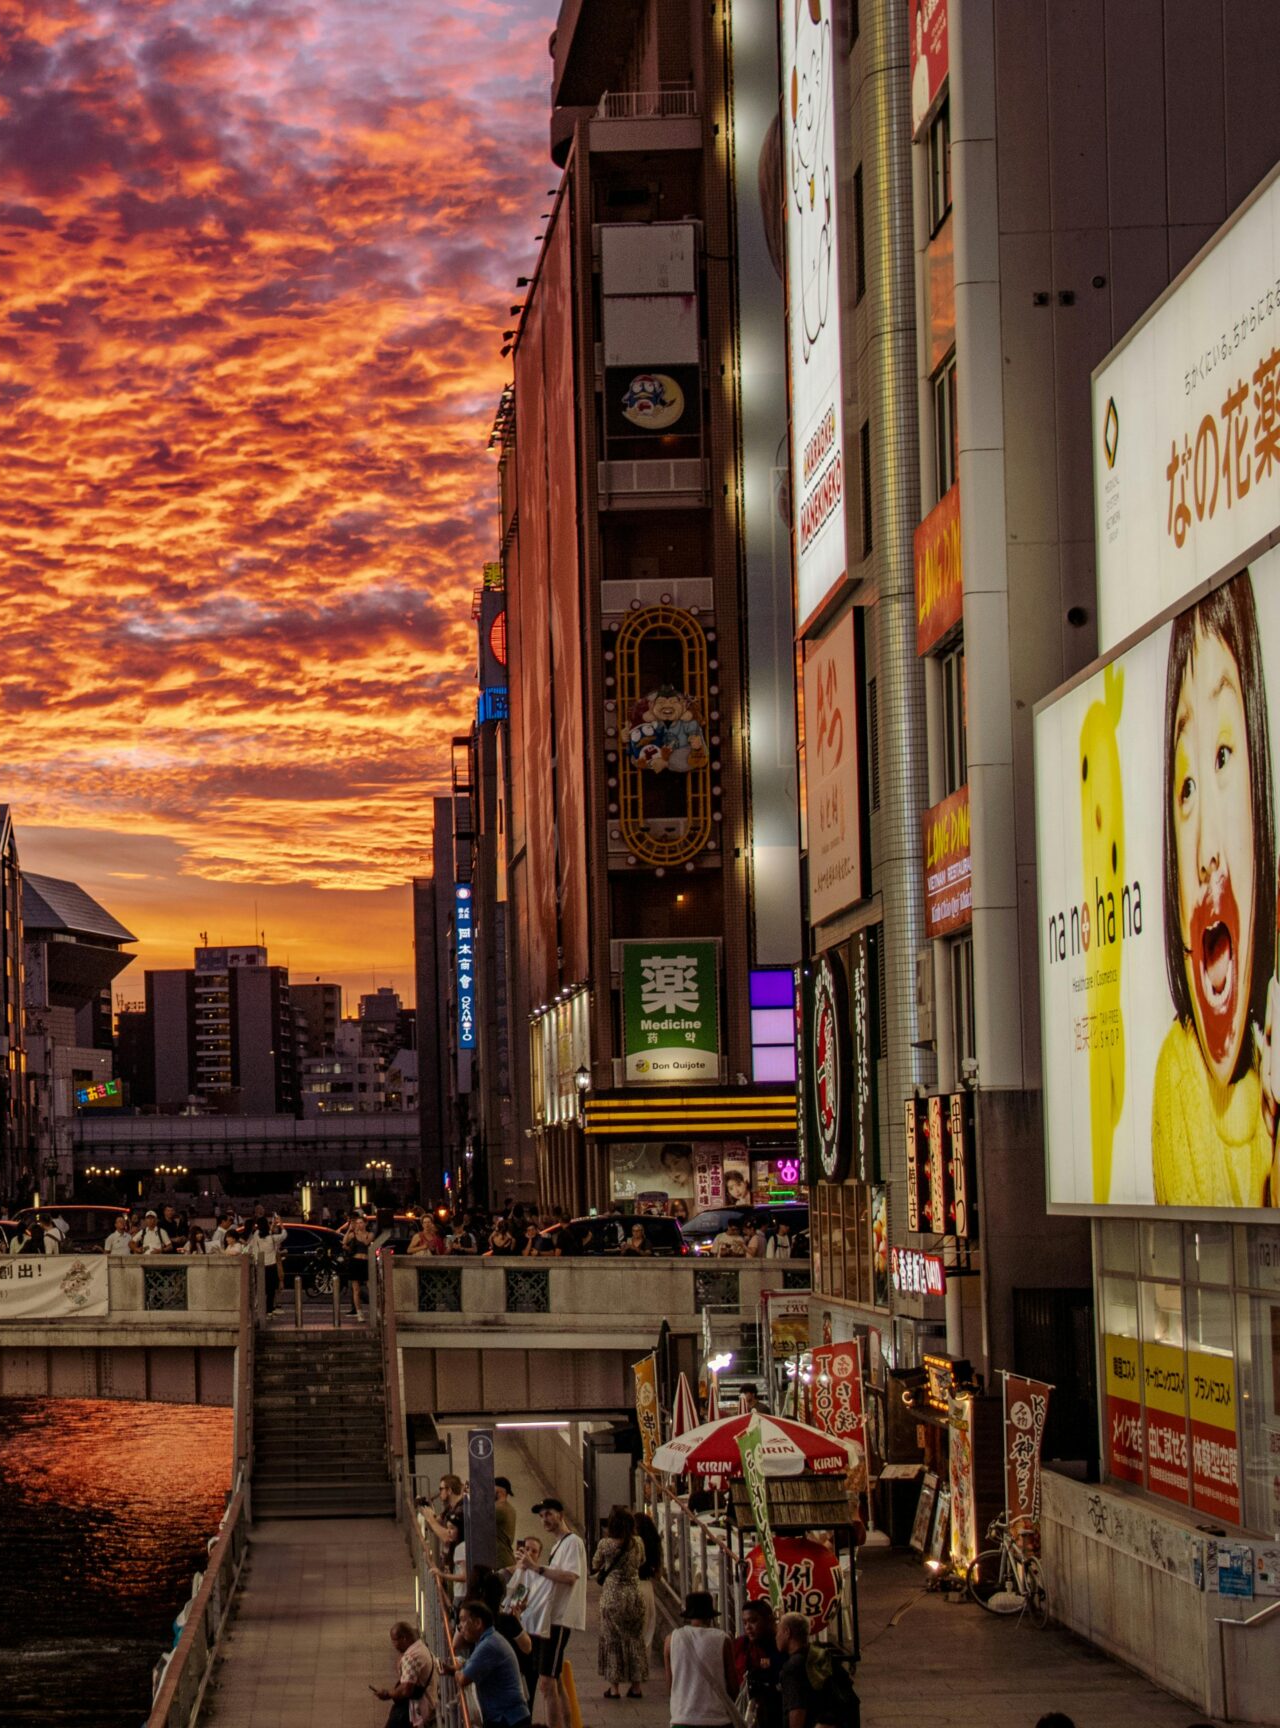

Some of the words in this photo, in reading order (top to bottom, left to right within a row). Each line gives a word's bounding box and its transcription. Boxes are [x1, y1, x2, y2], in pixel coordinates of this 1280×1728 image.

[640, 955, 700, 1014] 薬
[461, 996, 472, 1041] OKAMOTO
[640, 1019, 702, 1031] Medicine
[647, 1032, 659, 1044] 药
[652, 1062, 670, 1070] Don
[672, 1061, 706, 1071] Quijote
[1193, 1375, 1231, 1406] ブランドコスメ
[760, 1445, 795, 1455] IRIN
[696, 1461, 732, 1473] KIRIN
[813, 1456, 842, 1470] KIRIN
